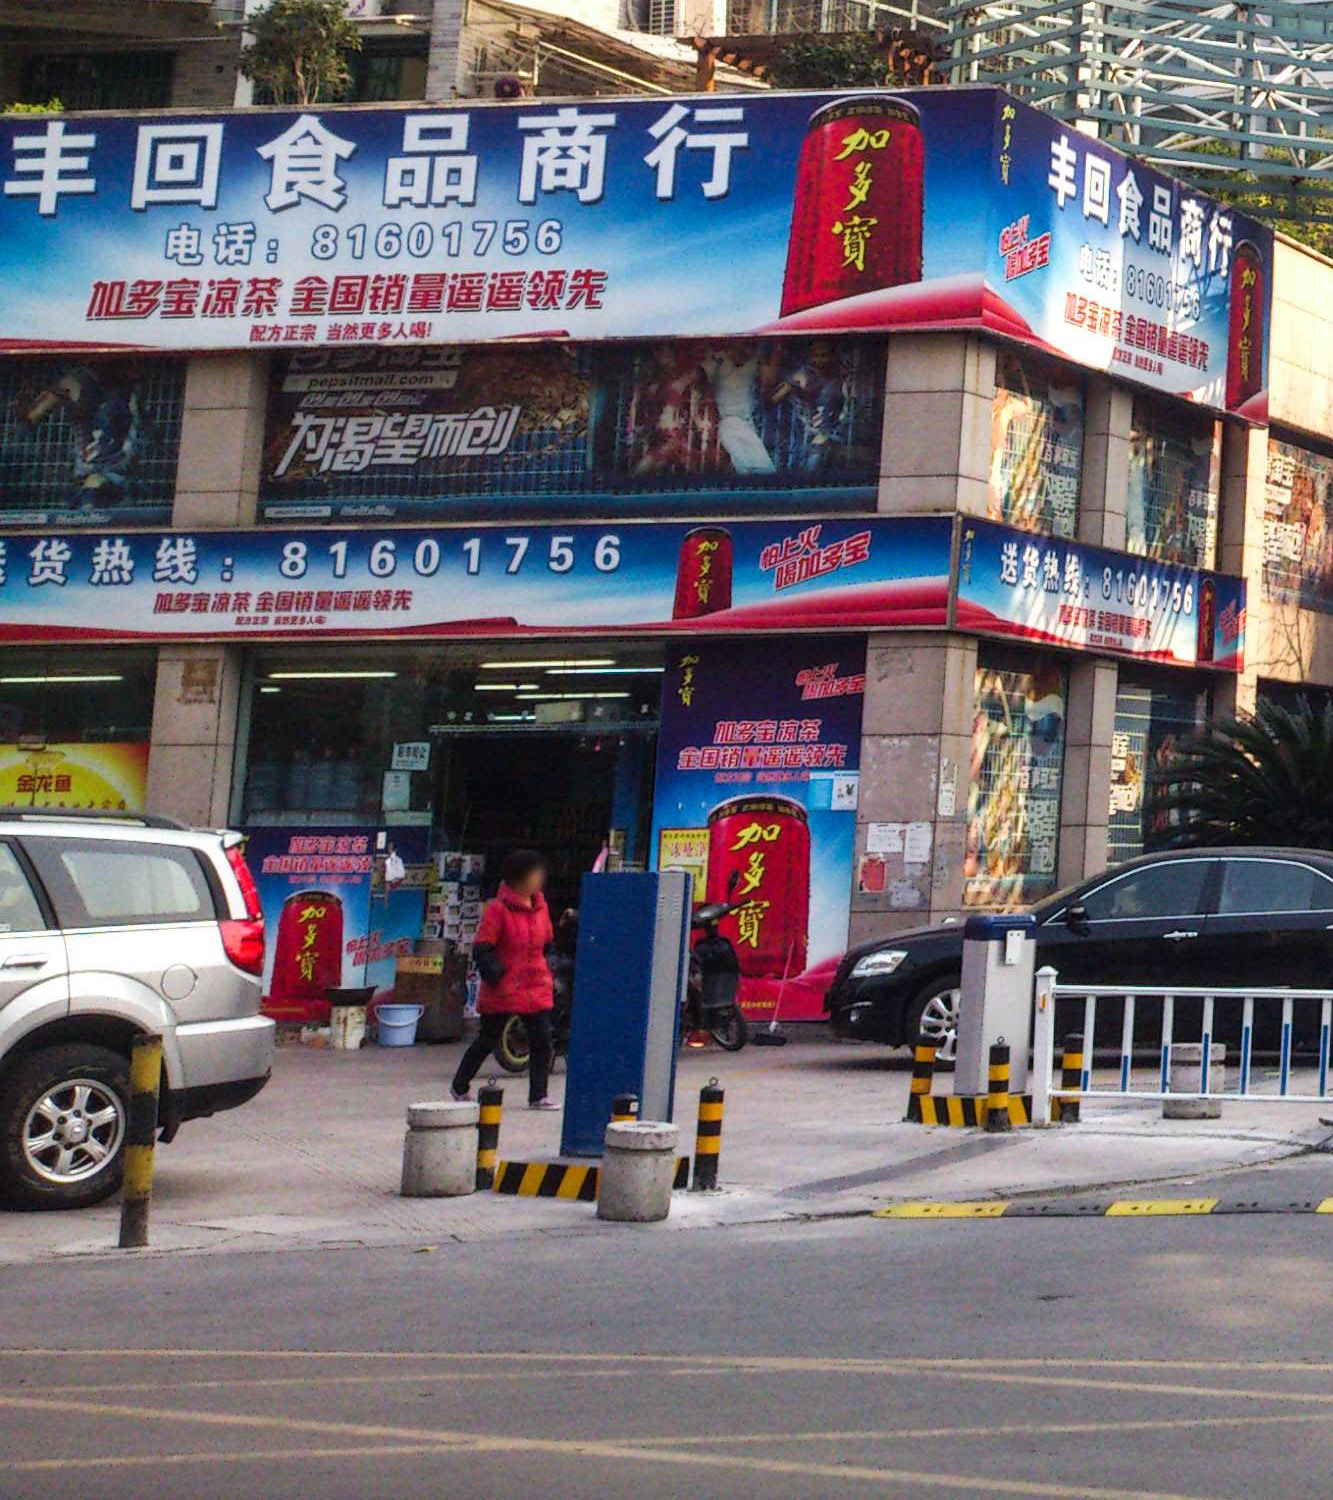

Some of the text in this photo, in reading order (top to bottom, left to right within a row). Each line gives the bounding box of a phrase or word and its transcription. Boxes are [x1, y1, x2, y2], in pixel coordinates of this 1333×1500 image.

[3, 103, 748, 215] 丰回食品商行
[1049, 135, 1233, 278] 丰回食品商行
[310, 219, 563, 260] 81601756
[86, 268, 607, 320] 加多宝凉茶 全国销量遥遥领先
[1126, 264, 1201, 320] 81601756
[249, 324, 317, 342] 配方正宗
[273, 405, 522, 477] 为渴望而创
[0, 534, 622, 587] 货热线： 81601756
[761, 525, 822, 571] 怕上火
[774, 531, 872, 592] 喝加多宝
[1102, 566, 1194, 617] 81601756
[677, 743, 847, 771] 全国销量遥遥领先
[713, 719, 822, 745] 加多宝凉茶
[16, 774, 72, 793] 金龙鱼
